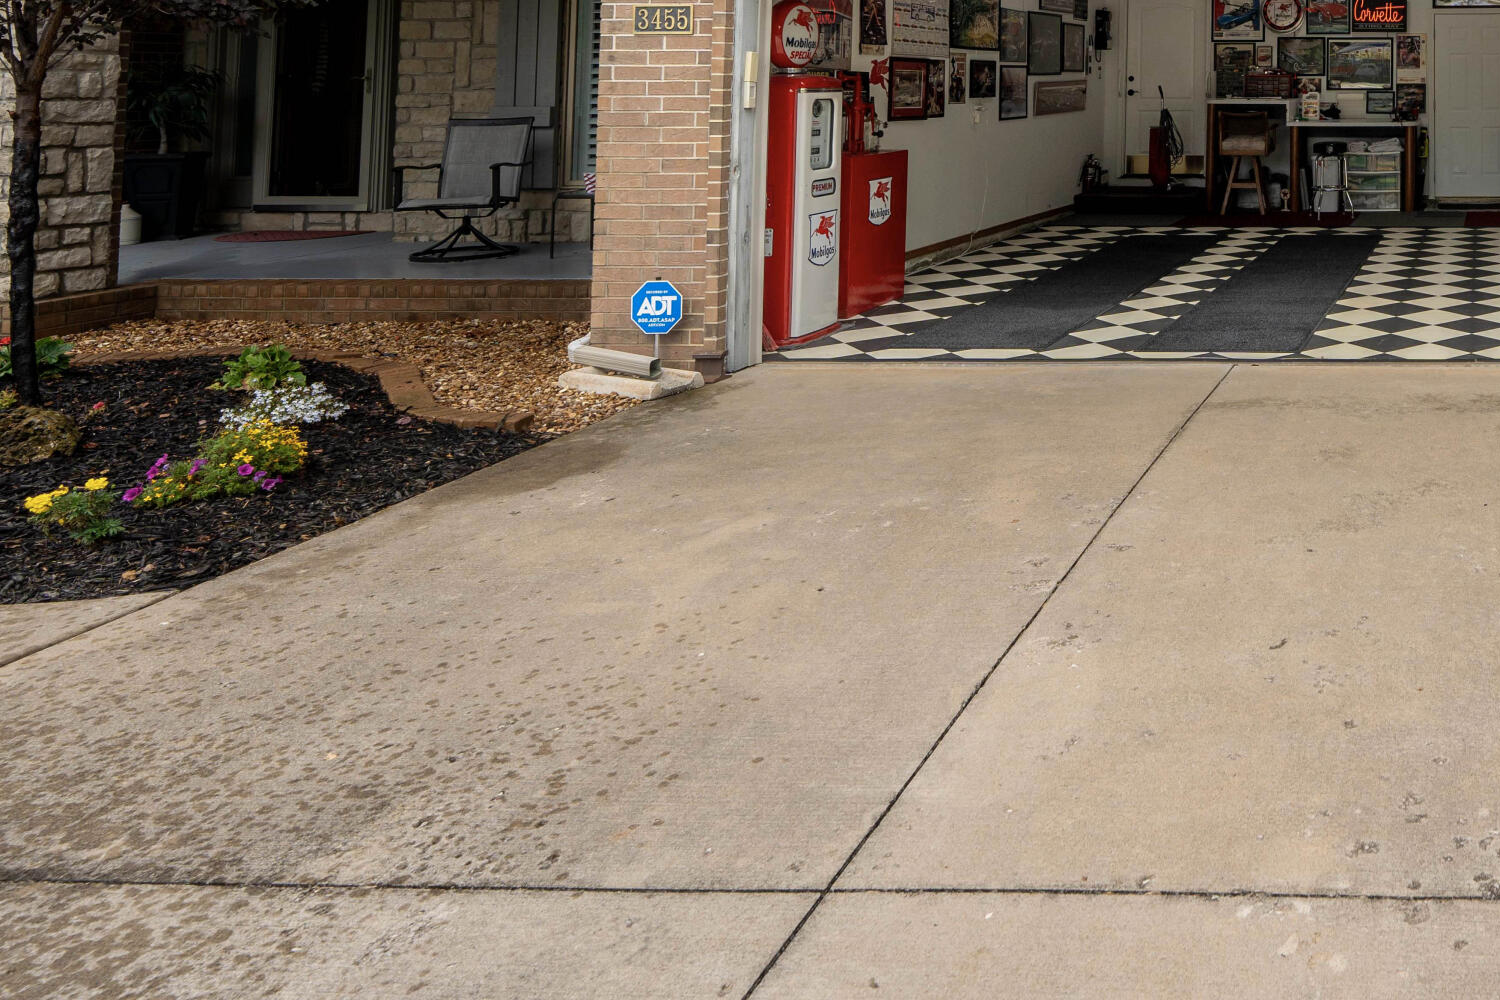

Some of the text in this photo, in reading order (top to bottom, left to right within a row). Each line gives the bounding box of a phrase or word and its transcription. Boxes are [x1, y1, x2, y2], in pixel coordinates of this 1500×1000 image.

[637, 8, 688, 30] 3455
[785, 36, 817, 52] Mobilgas
[790, 50, 813, 60] SPECIAL
[812, 182, 833, 192] PREMIUM
[870, 207, 890, 220] Mobilgas
[811, 245, 835, 259] Mobilgas
[636, 295, 677, 316] ADT
